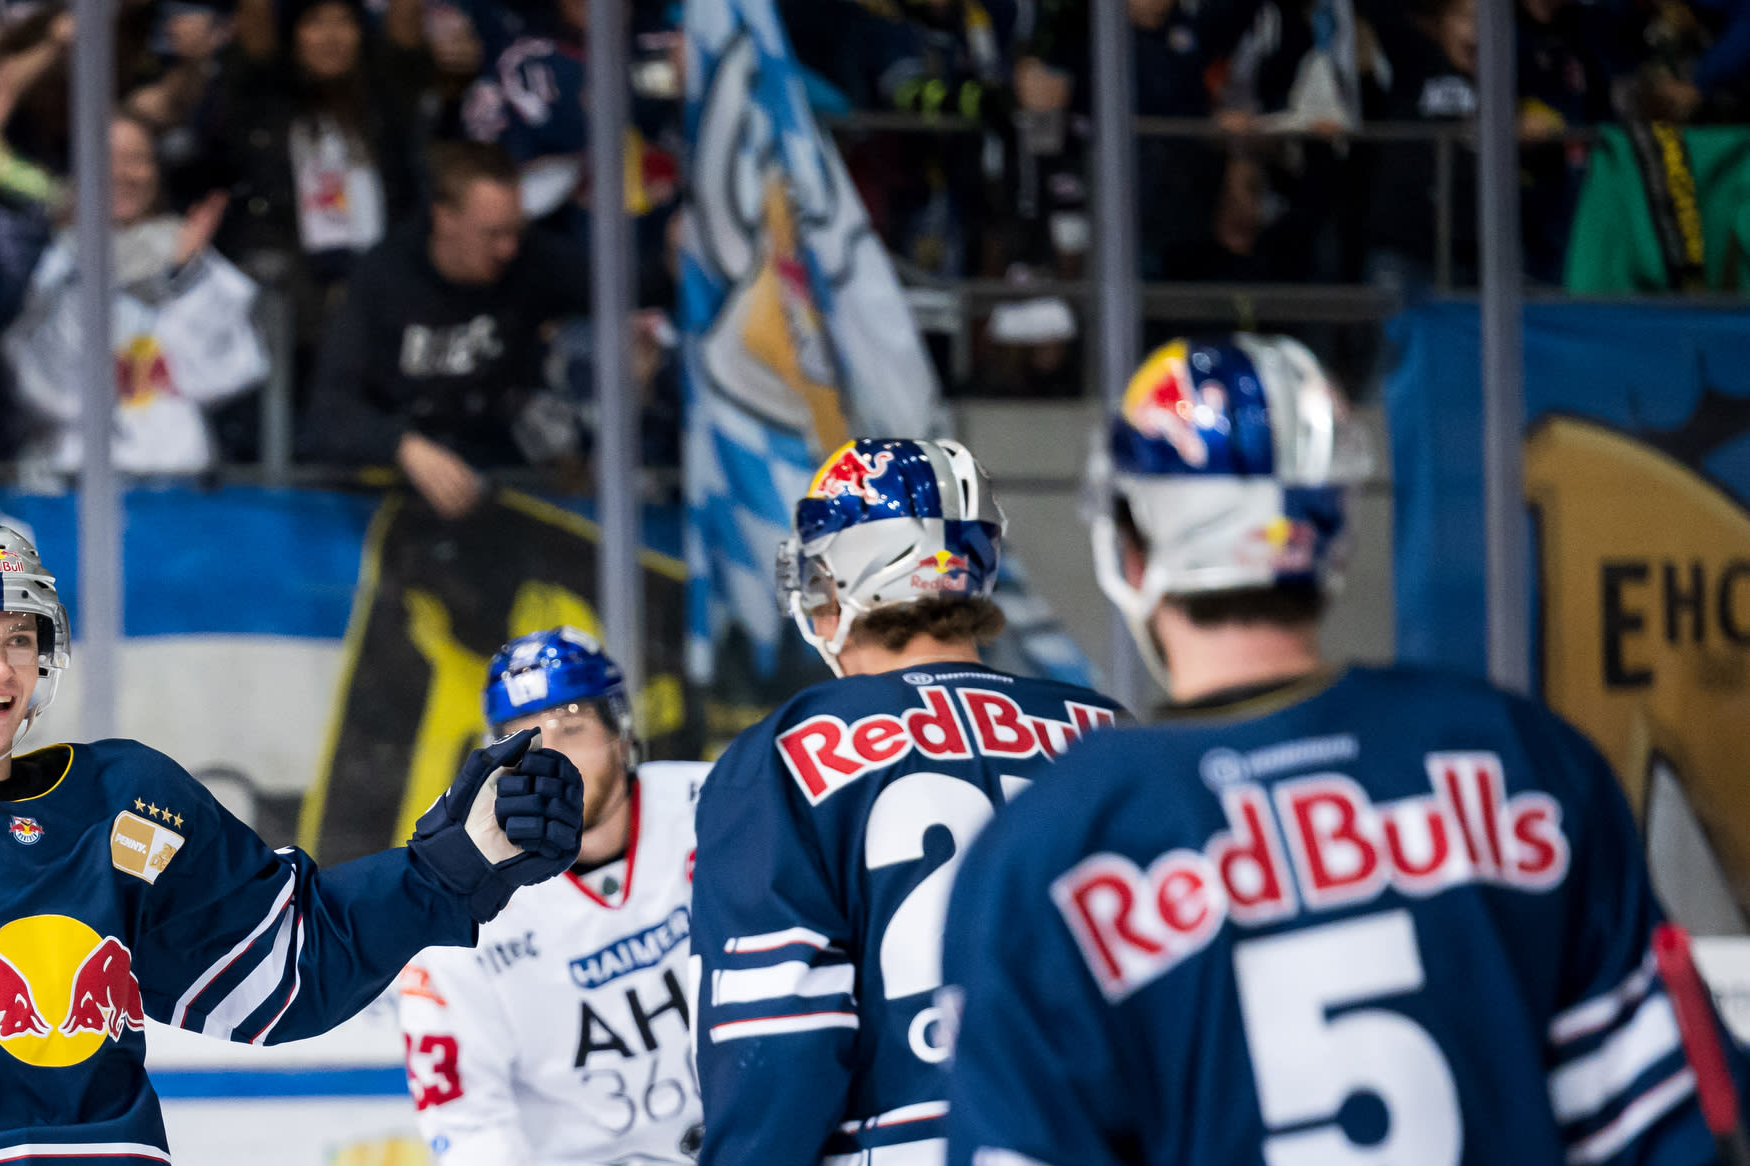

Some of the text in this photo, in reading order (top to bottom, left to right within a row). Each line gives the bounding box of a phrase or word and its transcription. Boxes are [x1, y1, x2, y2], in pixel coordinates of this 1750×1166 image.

[2, 561, 24, 573] Bull
[774, 685, 974, 807] Red
[864, 771, 1034, 1001] 2
[1050, 750, 1570, 1003] Red Bulls
